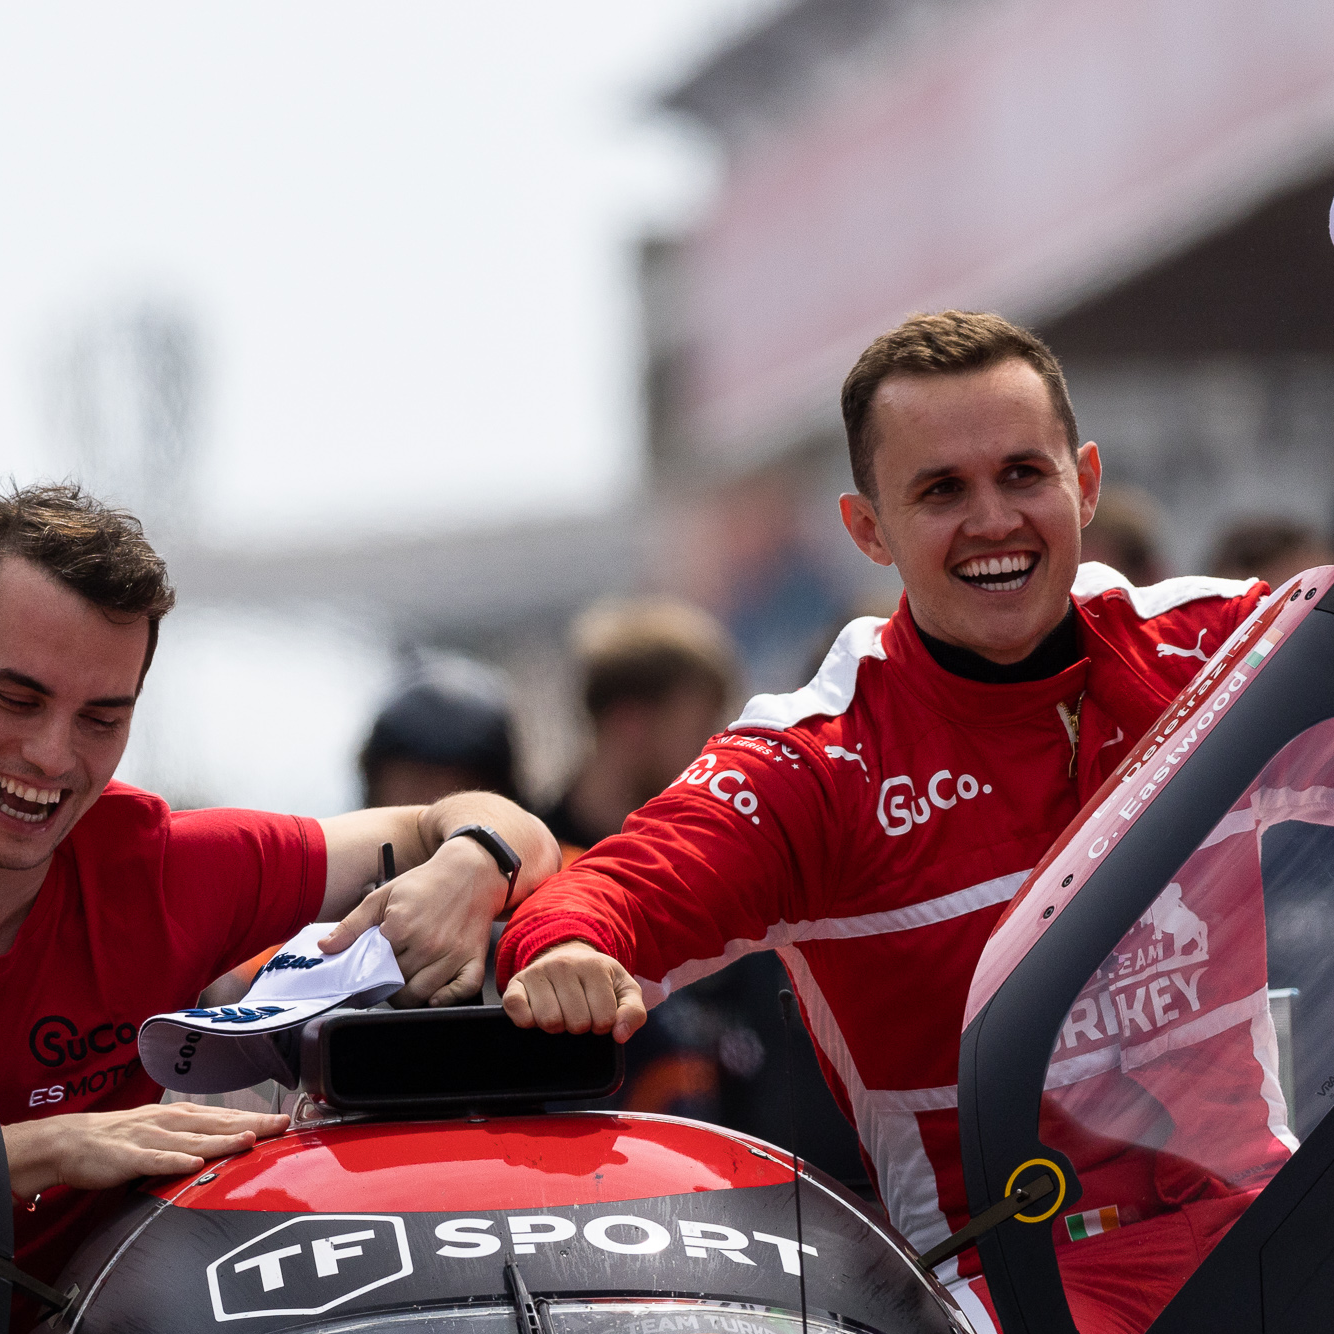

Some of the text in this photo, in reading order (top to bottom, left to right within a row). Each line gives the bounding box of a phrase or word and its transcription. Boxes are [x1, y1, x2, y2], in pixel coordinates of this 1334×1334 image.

[732, 739, 773, 755] SERIES
[1087, 830, 1120, 860] C.
[1118, 670, 1248, 822] Eastwood
[876, 769, 994, 837] SuCo.
[28, 1058, 142, 1107] ESMOTO
[233, 1214, 819, 1293] TF SPORT
